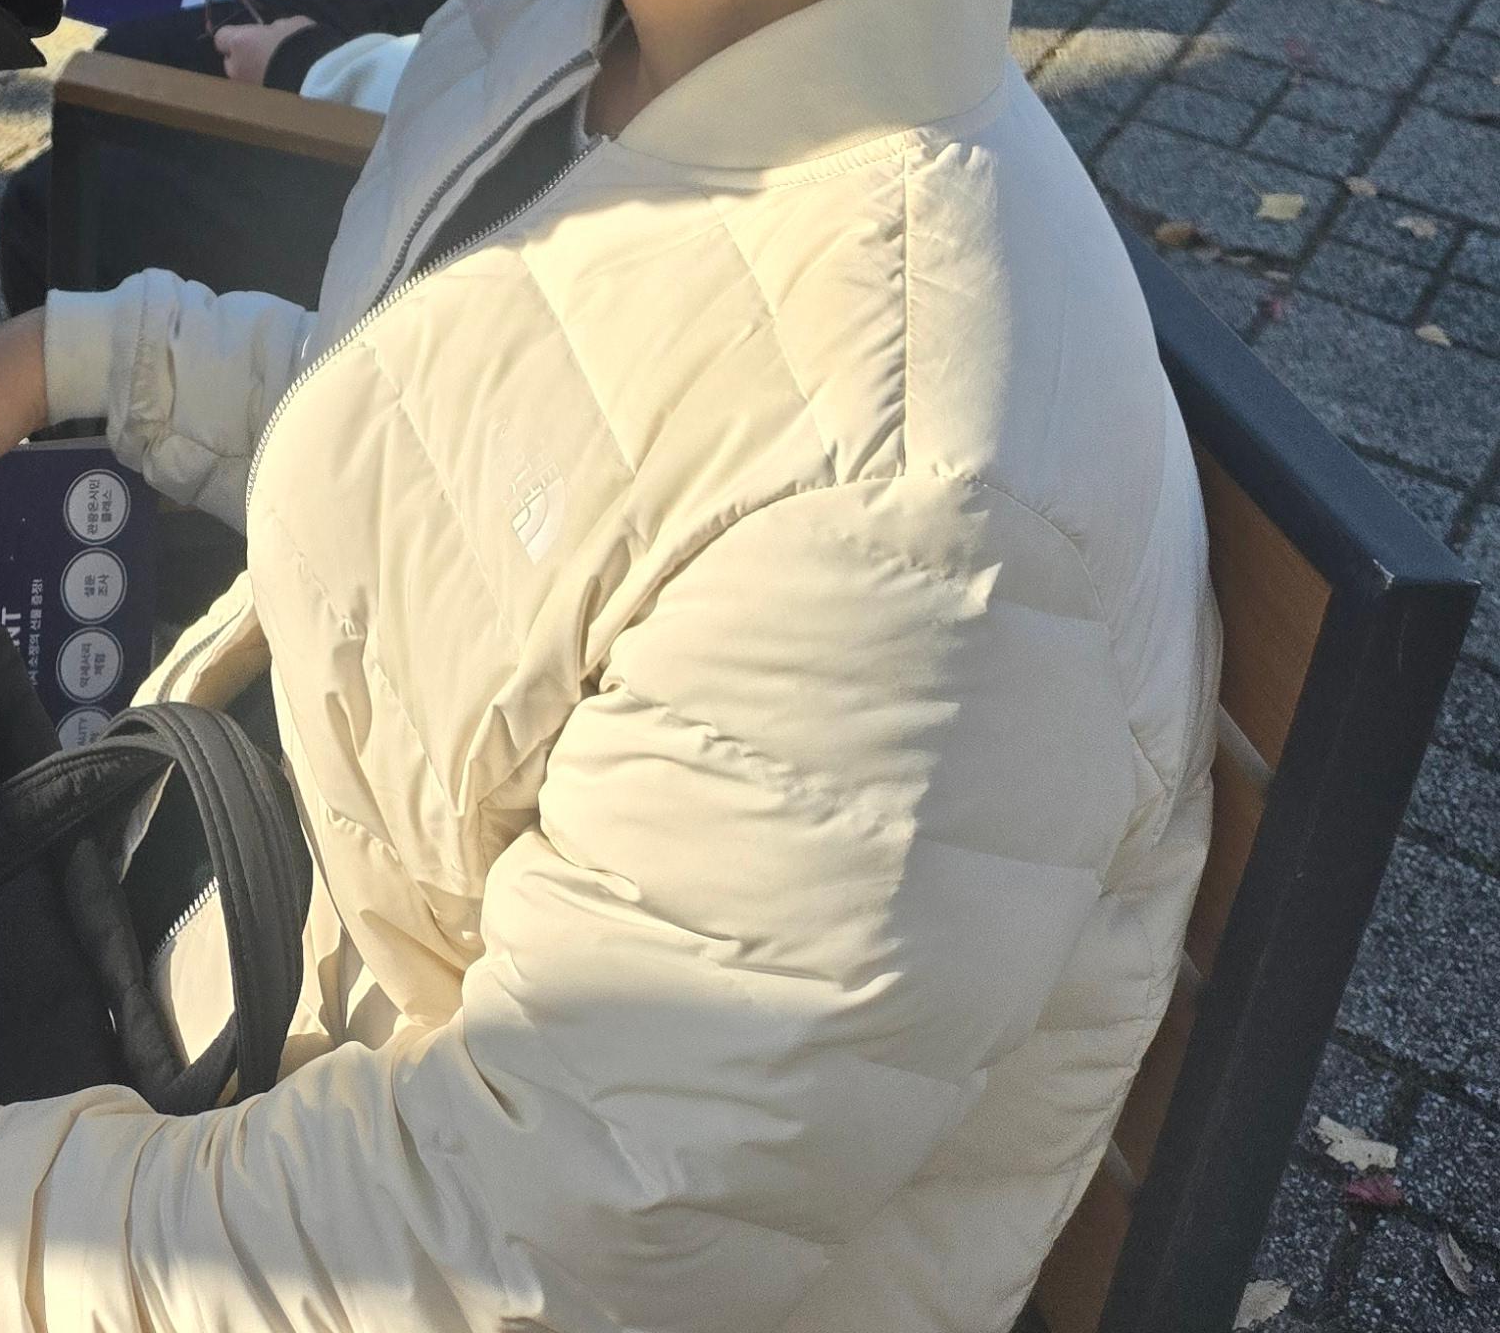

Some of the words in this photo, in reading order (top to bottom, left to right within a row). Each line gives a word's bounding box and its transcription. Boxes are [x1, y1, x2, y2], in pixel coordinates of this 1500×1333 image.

[101, 489, 112, 523] 클래스
[84, 574, 95, 598] 설문
[98, 573, 109, 597] 조사
[30, 609, 42, 630] 선물
[28, 634, 40, 669] 소정의
